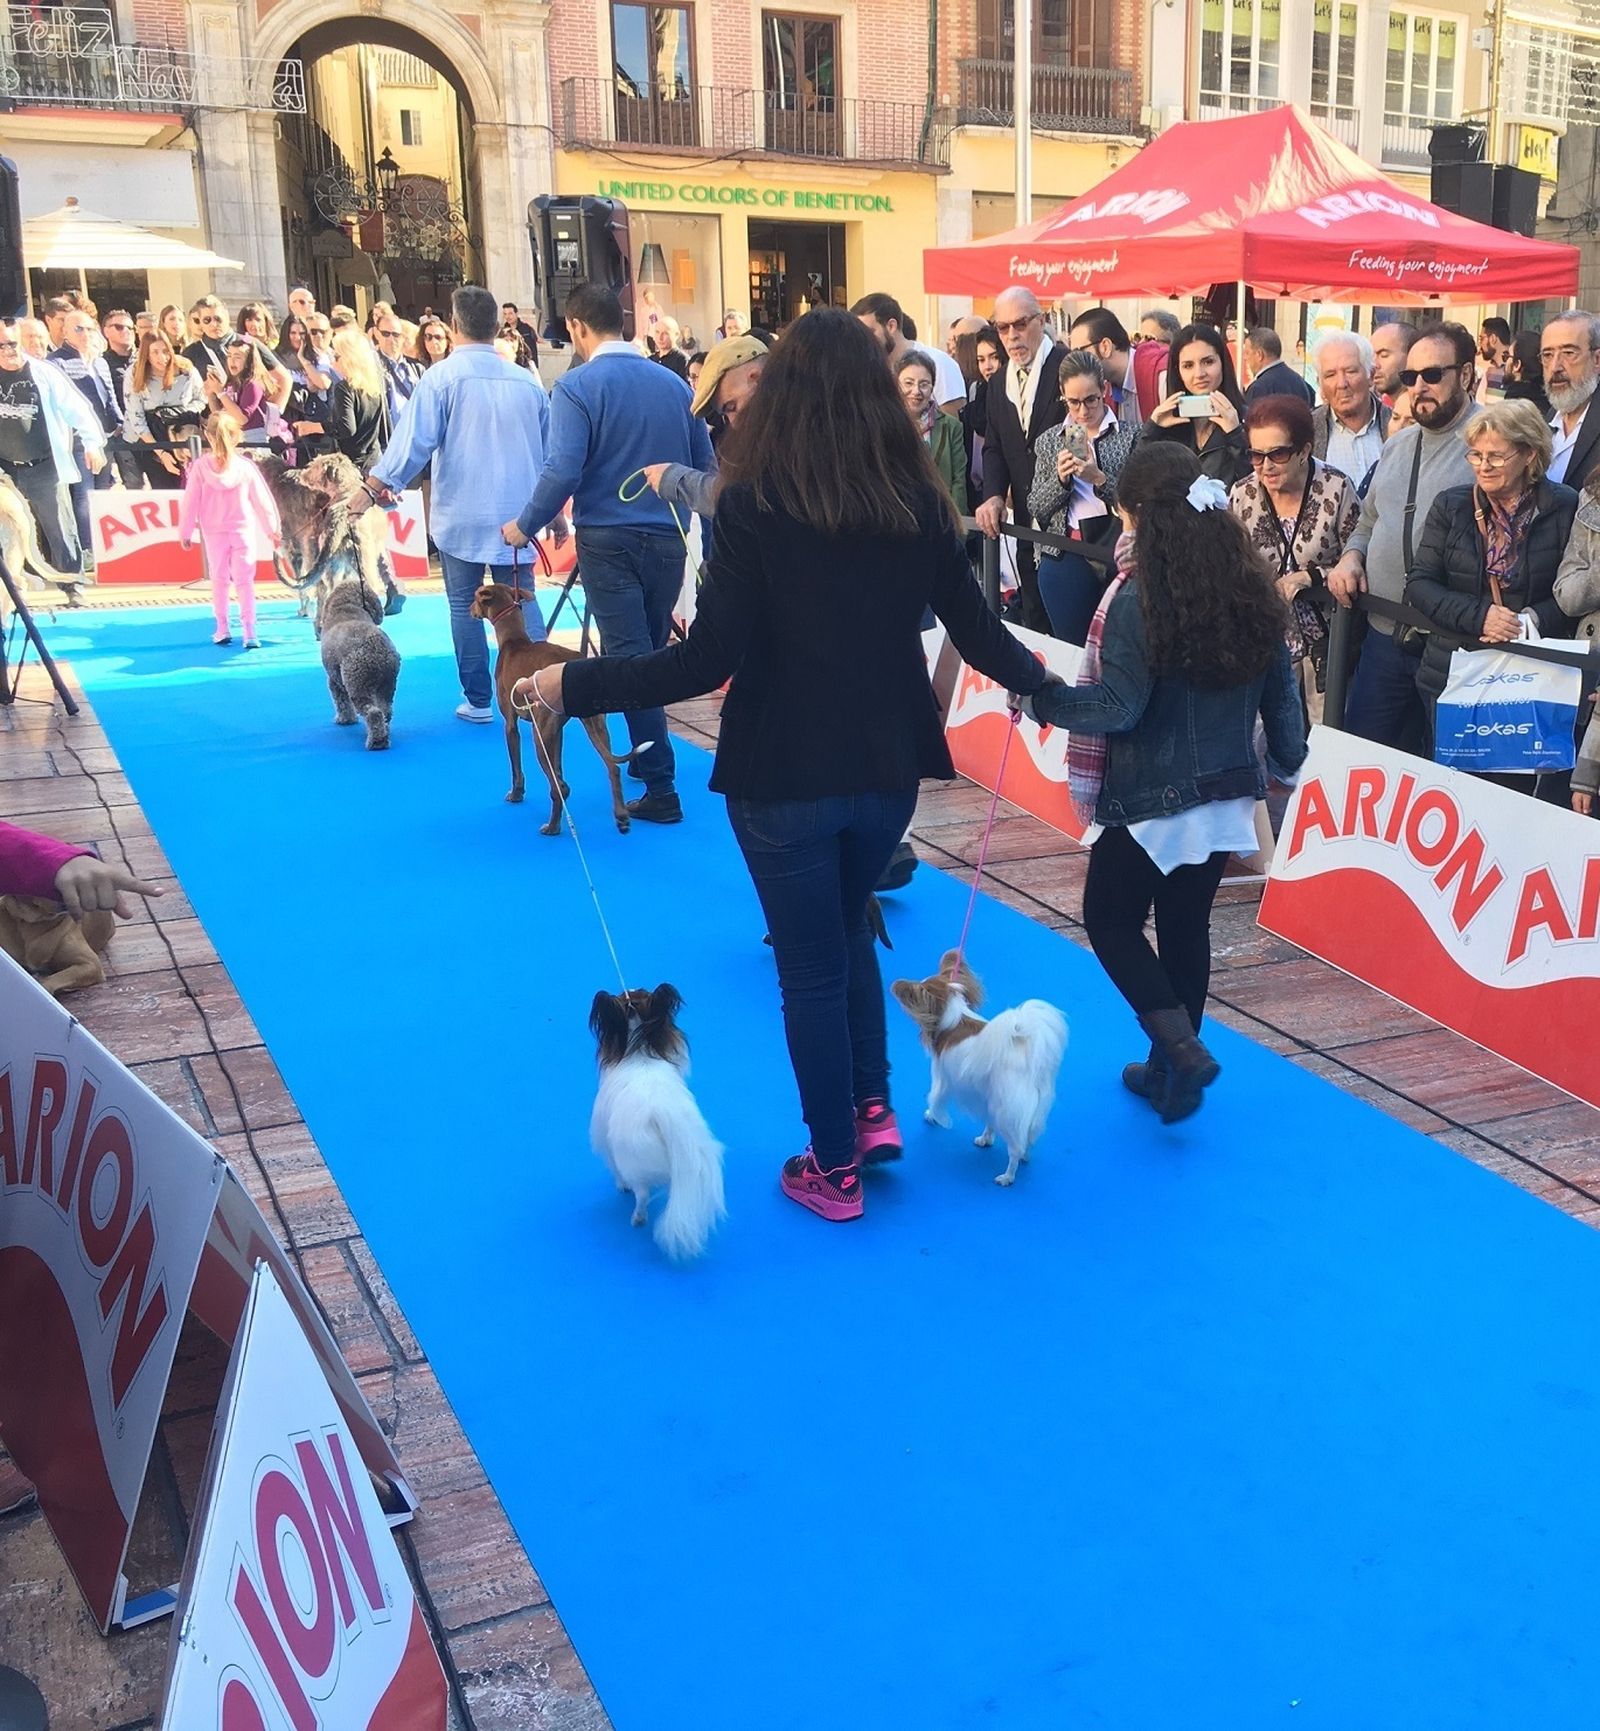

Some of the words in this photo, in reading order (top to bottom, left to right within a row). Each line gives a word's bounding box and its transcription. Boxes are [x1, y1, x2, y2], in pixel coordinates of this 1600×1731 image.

[1523, 134, 1549, 163] Hey!
[598, 180, 675, 200] UNITED
[678, 184, 759, 206] COLORS
[762, 188, 789, 207] OF
[1048, 188, 1191, 231] ARION
[1295, 189, 1441, 229] ARION
[1009, 255, 1044, 282] Feeding
[1043, 261, 1065, 287] your
[1067, 249, 1119, 285] enjoyment
[1348, 249, 1396, 277] Feeding
[1395, 259, 1426, 281] your
[1428, 257, 1489, 283] enjoyment
[1286, 766, 1505, 935] ARION
